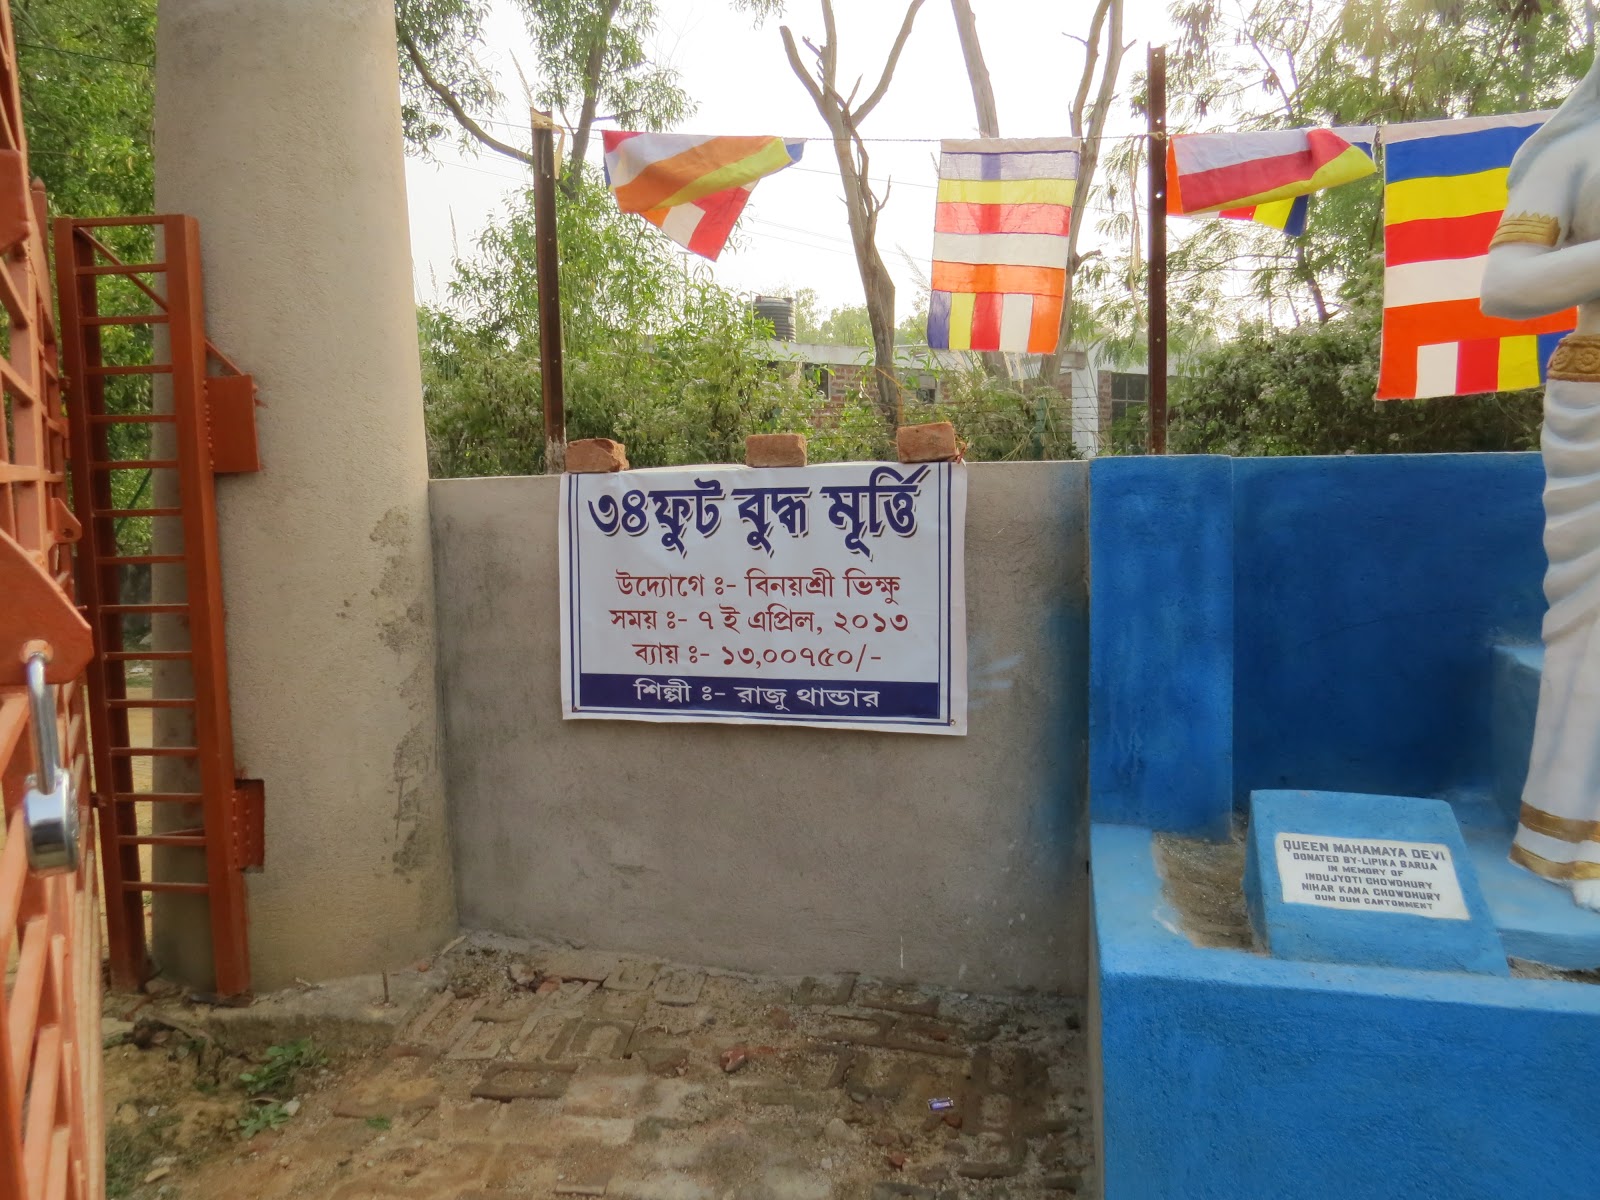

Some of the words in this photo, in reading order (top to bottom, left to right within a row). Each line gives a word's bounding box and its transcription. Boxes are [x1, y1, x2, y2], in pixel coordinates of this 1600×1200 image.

[731, 486, 812, 558] বুদ্ধ
[615, 568, 705, 597] উদ্যোগে
[744, 567, 835, 597] বিনয়শ্রী
[843, 567, 901, 605] ভিক্ষু
[608, 609, 658, 630] সময়
[698, 611, 714, 630] ৭
[719, 603, 741, 634] ই
[747, 602, 823, 635] এপ্রিল,
[834, 612, 909, 634] ২০১৩
[632, 642, 680, 666] ব্যায়
[632, 677, 693, 704] শিল্পী
[733, 685, 790, 712] রাজু
[1283, 840, 1329, 852] QUEEN
[1333, 843, 1407, 858] MAHAMAYA
[1411, 849, 1446, 861] DEVI
[1293, 852, 1339, 863] DONATED
[1400, 860, 1437, 871] BARUA
[1342, 866, 1386, 876] MEMORY
[1390, 869, 1404, 877] OF
[1302, 882, 1335, 893] NIHAR
[1339, 886, 1369, 896] KANA
[1373, 888, 1441, 901] CHOWDHURY
[1305, 873, 1362, 884] INDUJYOTI
[1365, 877, 1432, 890] CHOWDHURY
[1315, 894, 1336, 902] DUM
[1339, 895, 1361, 904] DUM
[1364, 897, 1433, 910] CANTONMENT
